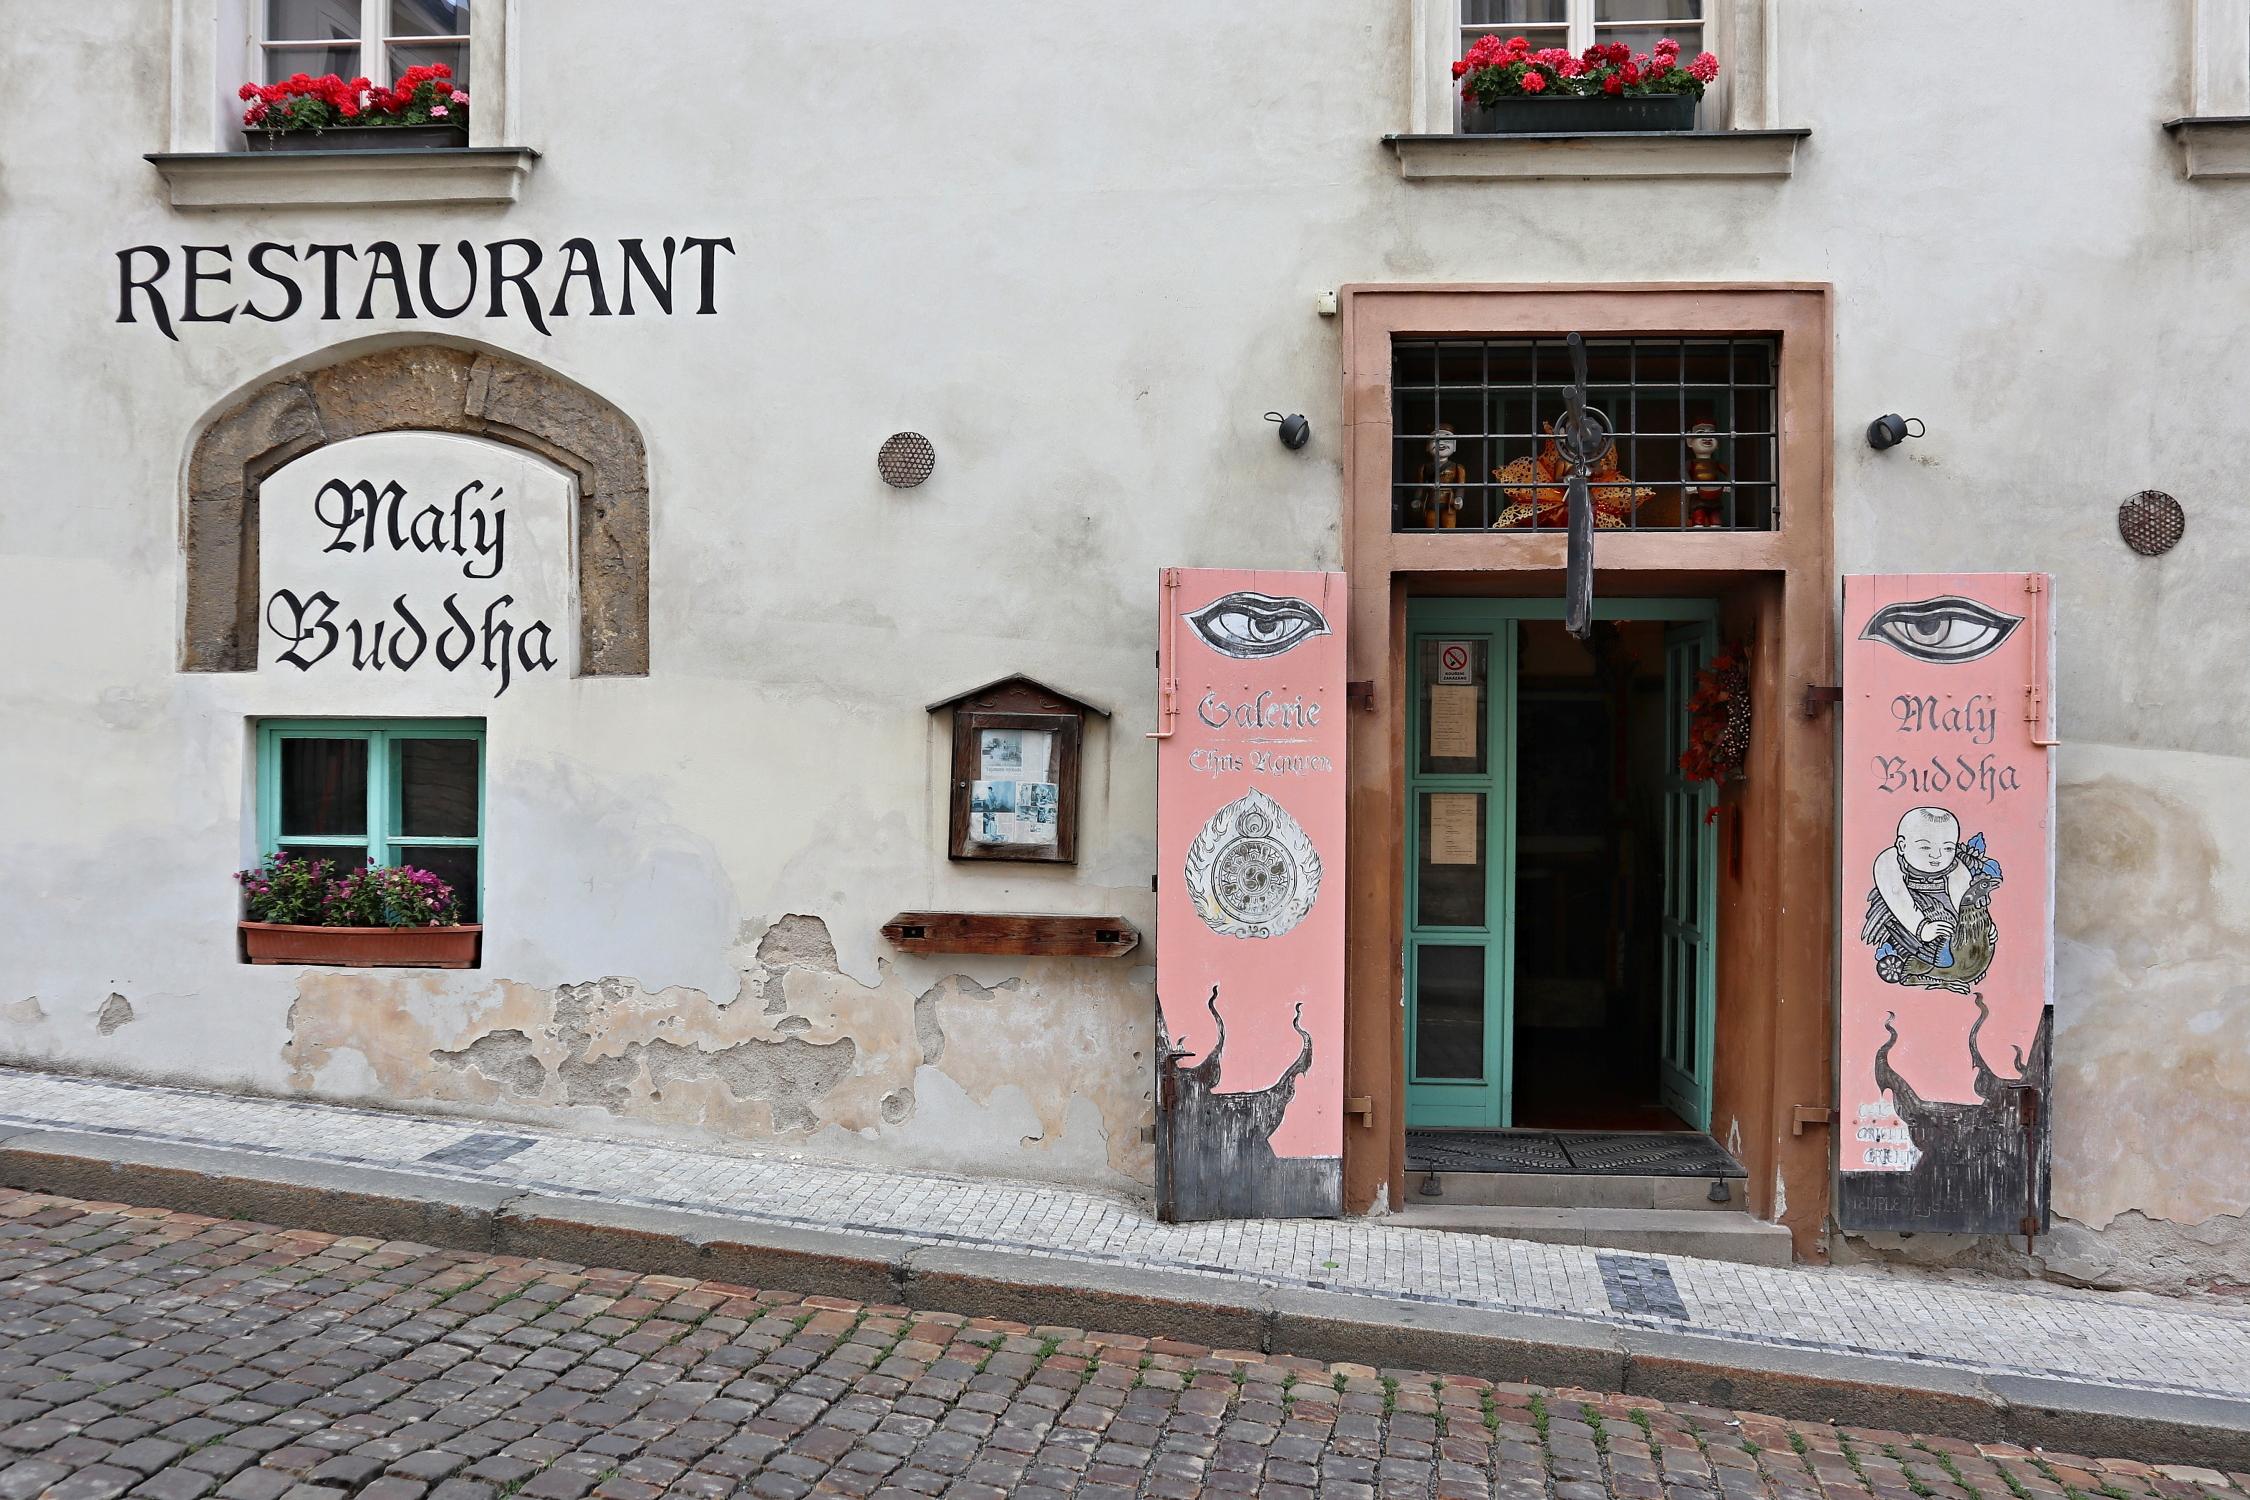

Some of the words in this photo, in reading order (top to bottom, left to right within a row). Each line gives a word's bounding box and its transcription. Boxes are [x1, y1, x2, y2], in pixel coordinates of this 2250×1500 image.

[116, 236, 736, 342] RESTAURANT
[314, 479, 506, 579] Malý
[266, 588, 558, 699] Buddha
[1198, 690, 1321, 729] Galerie
[1188, 748, 1244, 779] Chris
[1871, 753, 2021, 805] Buddha
